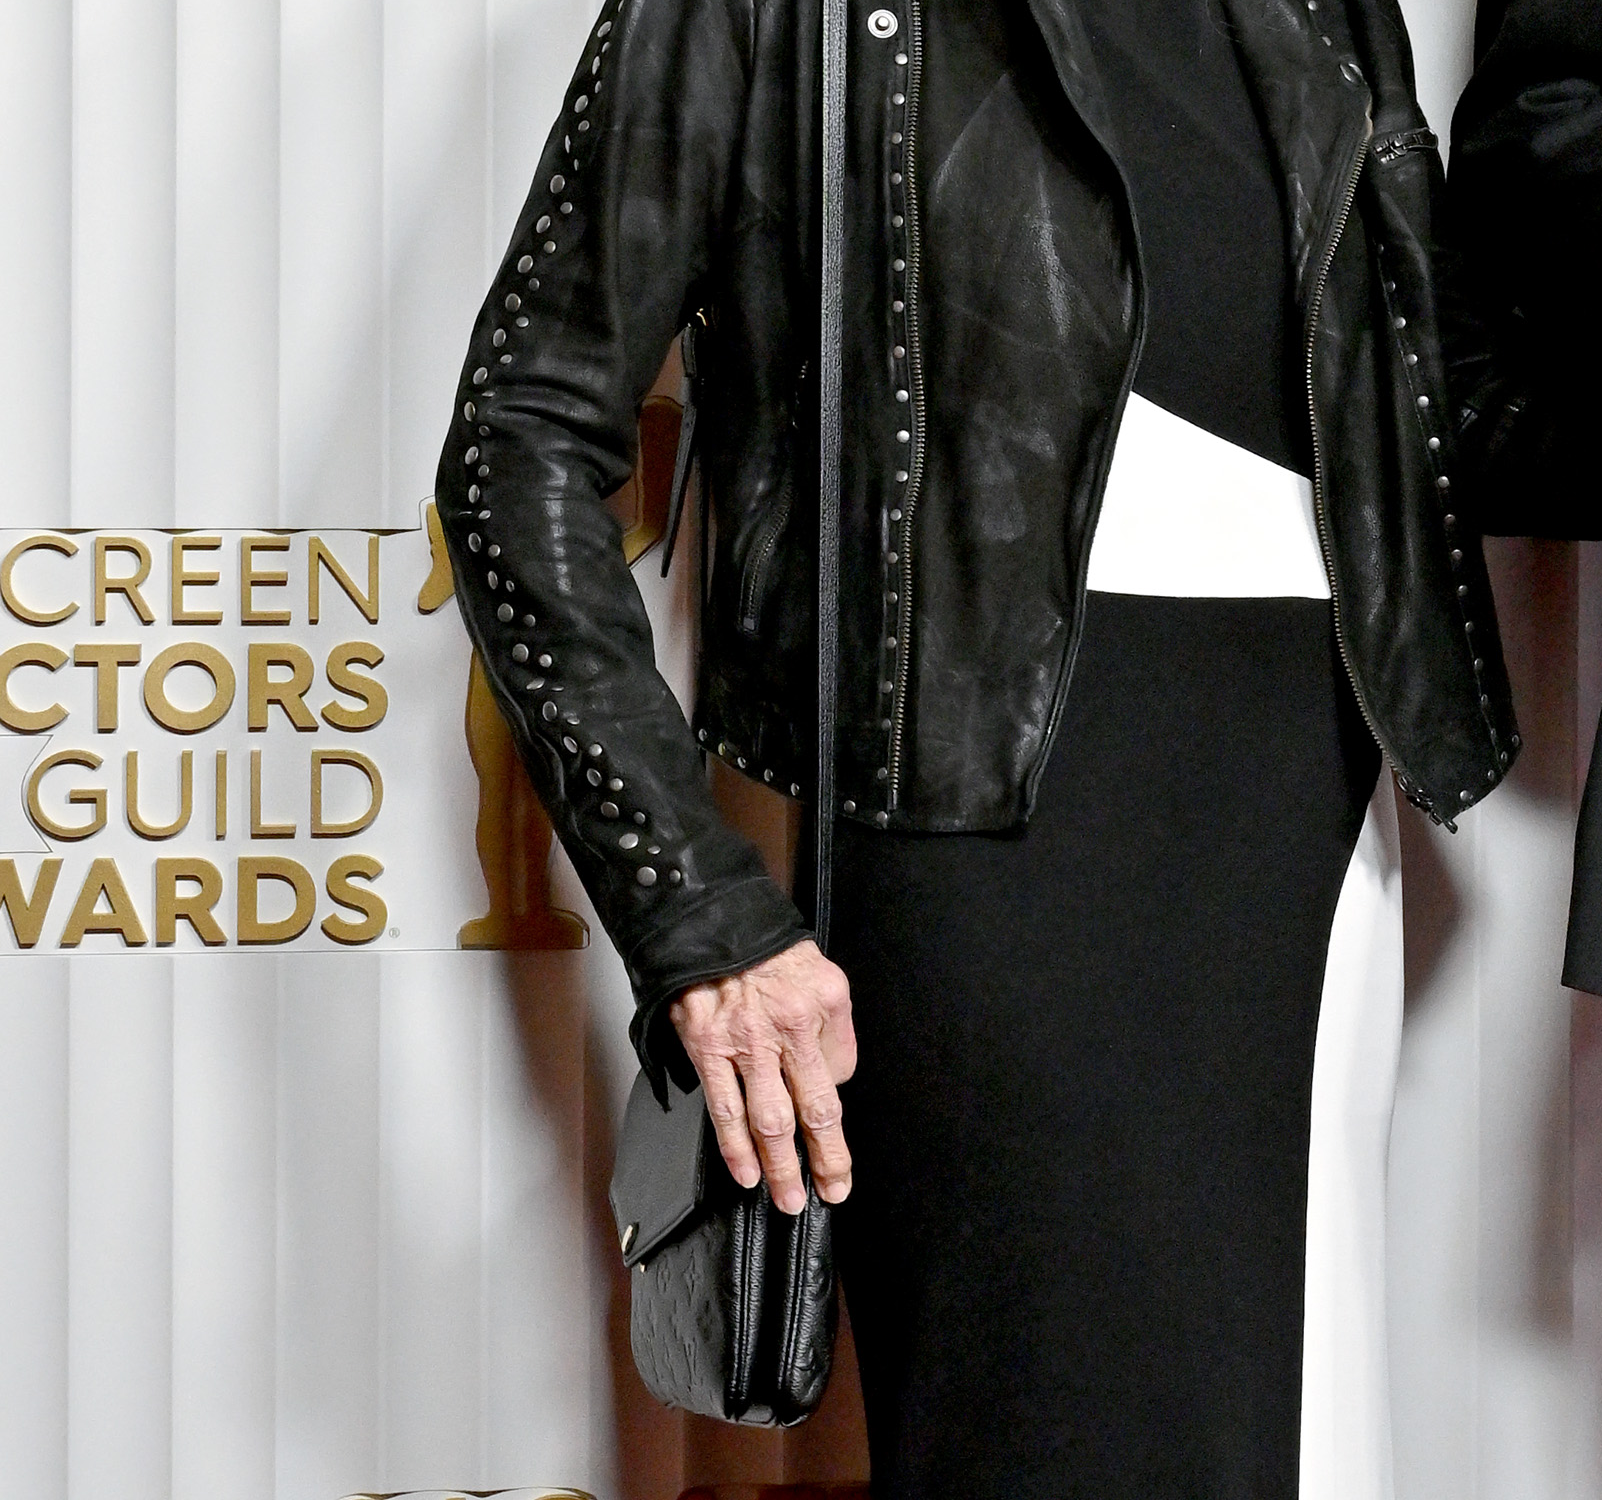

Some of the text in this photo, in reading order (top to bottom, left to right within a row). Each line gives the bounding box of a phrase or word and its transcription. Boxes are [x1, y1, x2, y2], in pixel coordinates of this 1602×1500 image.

[0, 534, 380, 626] CREEN
[0, 641, 389, 736] CTORS
[27, 748, 384, 843] GUILD
